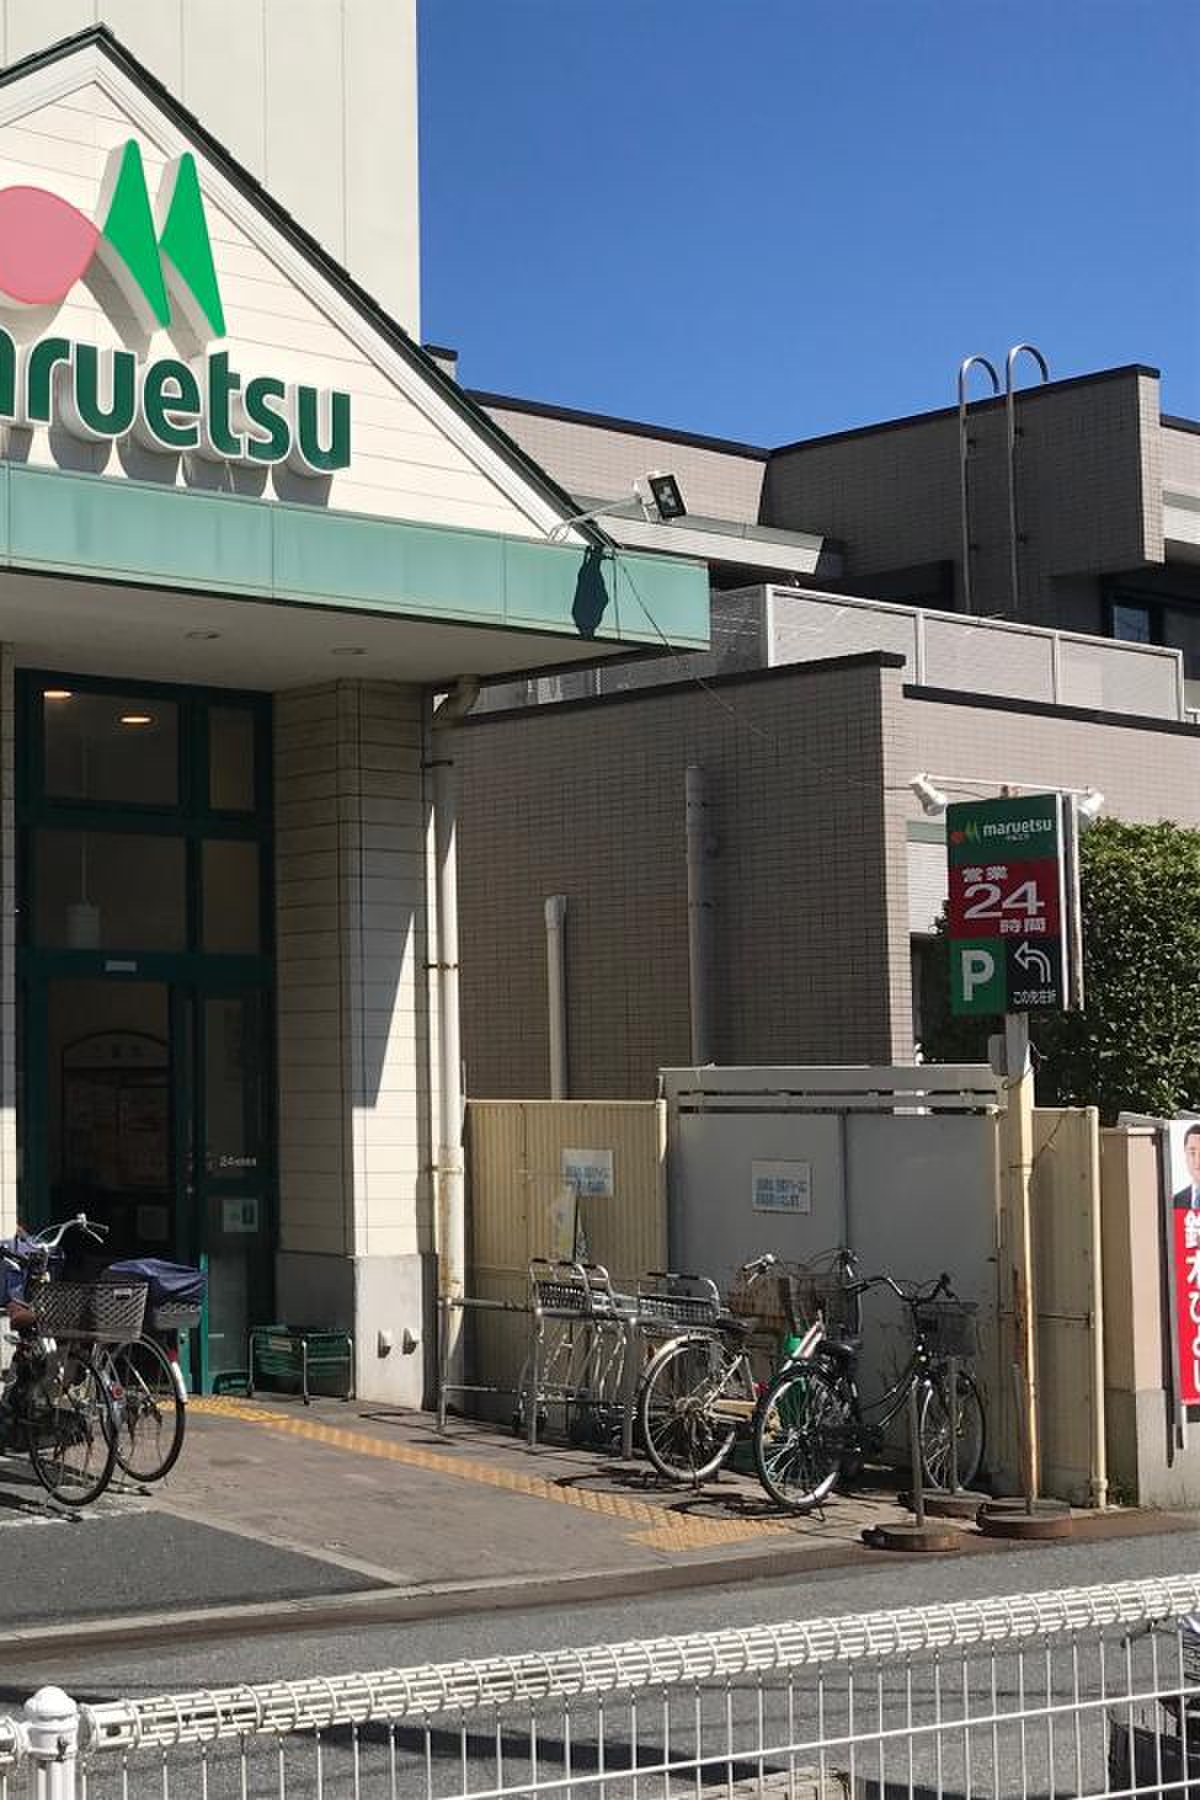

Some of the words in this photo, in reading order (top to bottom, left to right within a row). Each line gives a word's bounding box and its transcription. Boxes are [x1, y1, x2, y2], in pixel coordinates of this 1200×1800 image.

[983, 819, 1052, 837] maruetsu
[963, 880, 1046, 919] 24
[961, 949, 995, 1002] P
